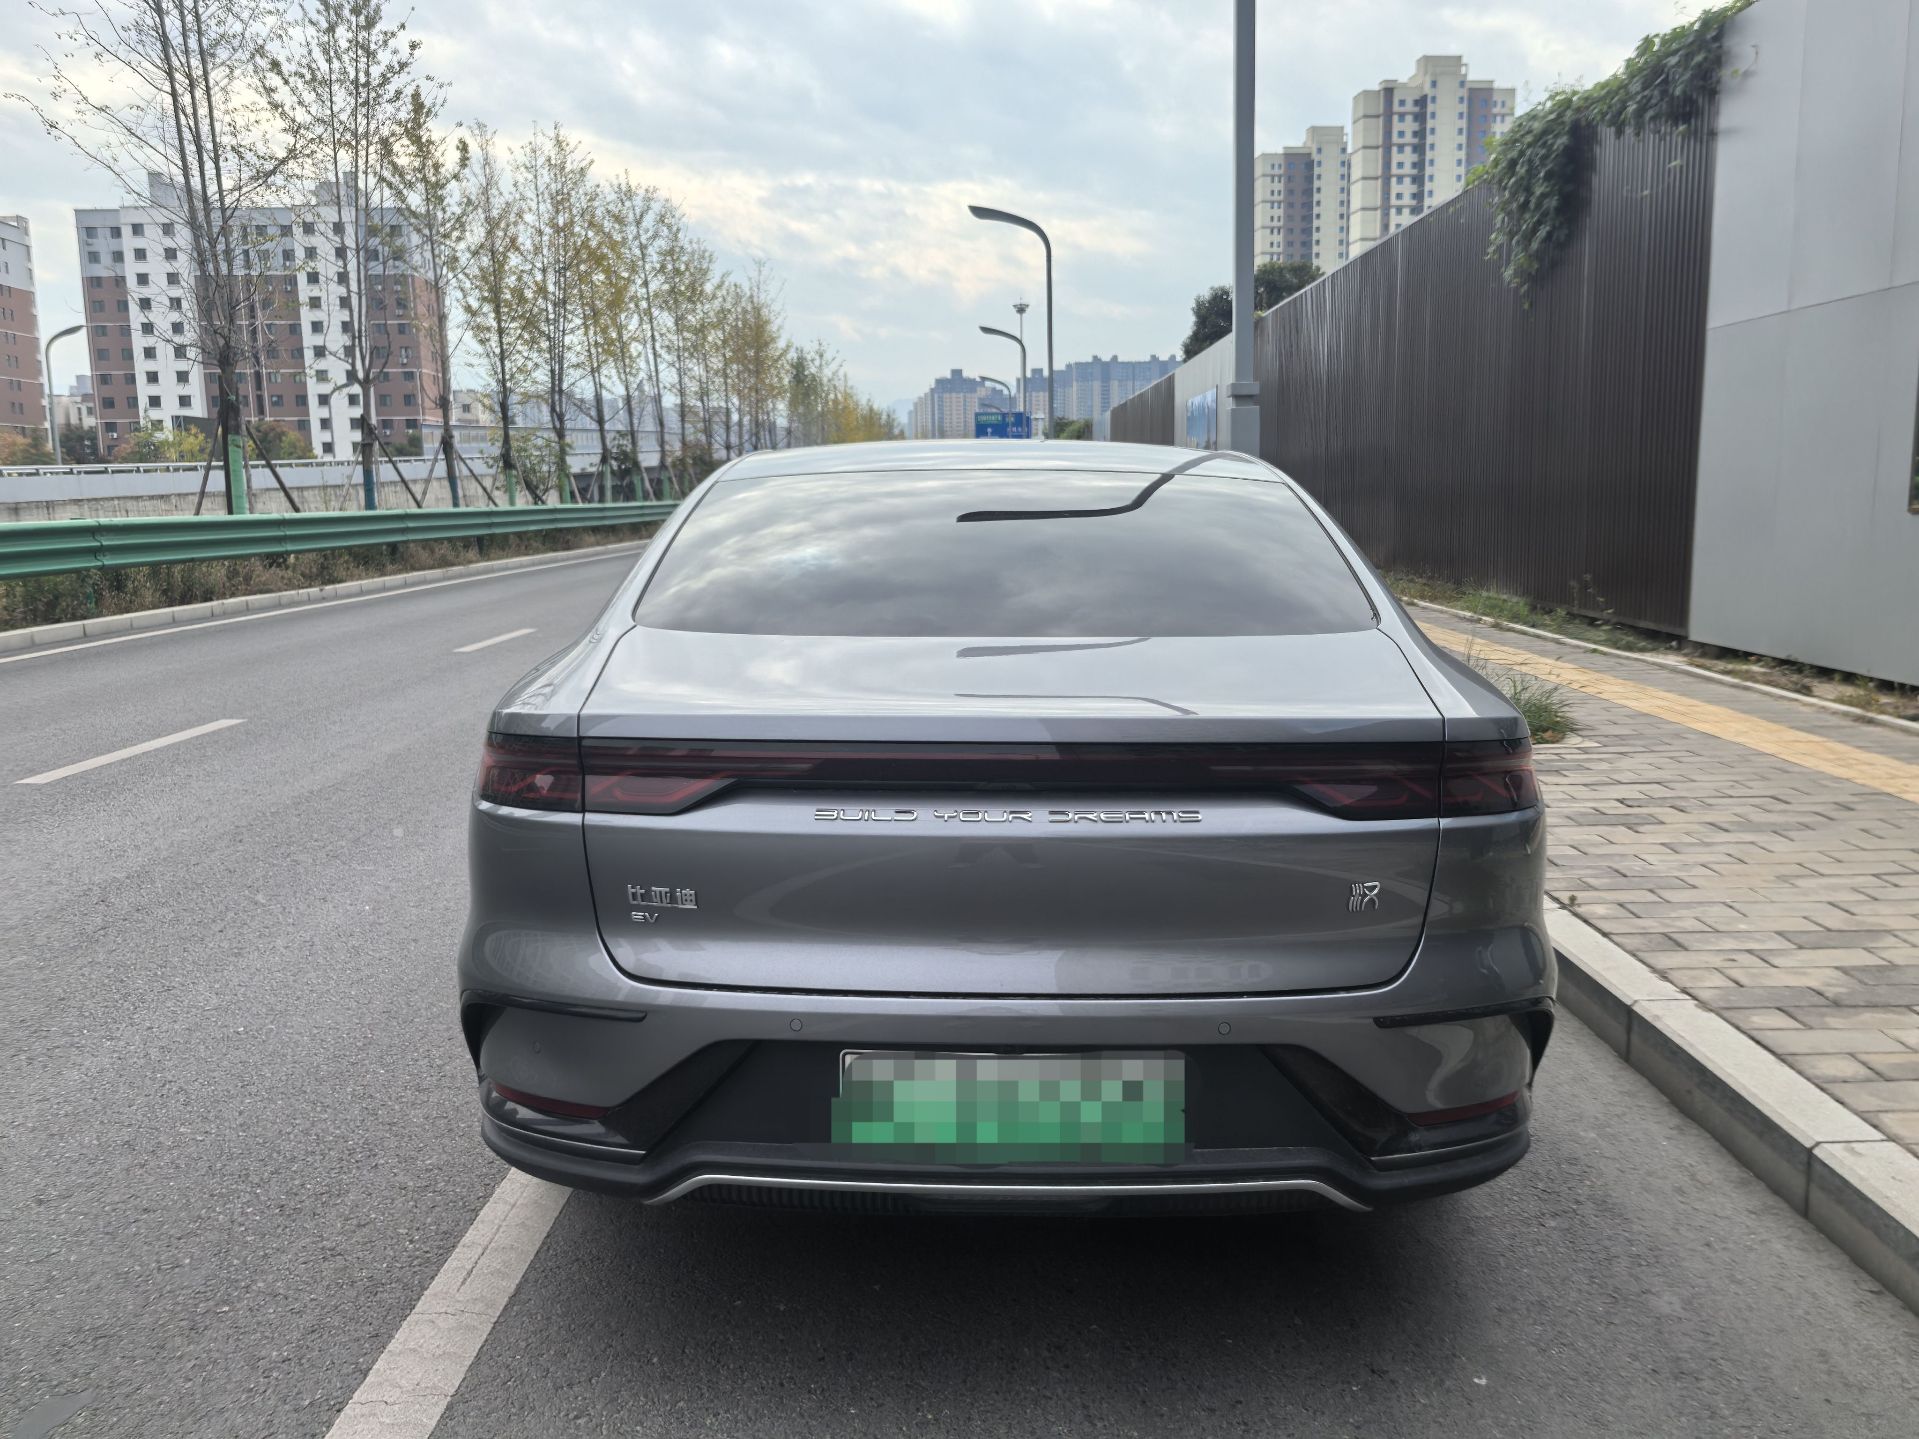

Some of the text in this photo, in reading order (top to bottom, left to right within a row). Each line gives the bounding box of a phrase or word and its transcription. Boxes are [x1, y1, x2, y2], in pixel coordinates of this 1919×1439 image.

[814, 808, 1203, 823] BUILD YOUR DREAMS
[627, 884, 698, 909] 比亚迪
[1349, 881, 1381, 912] 汉
[631, 911, 659, 923] EV
